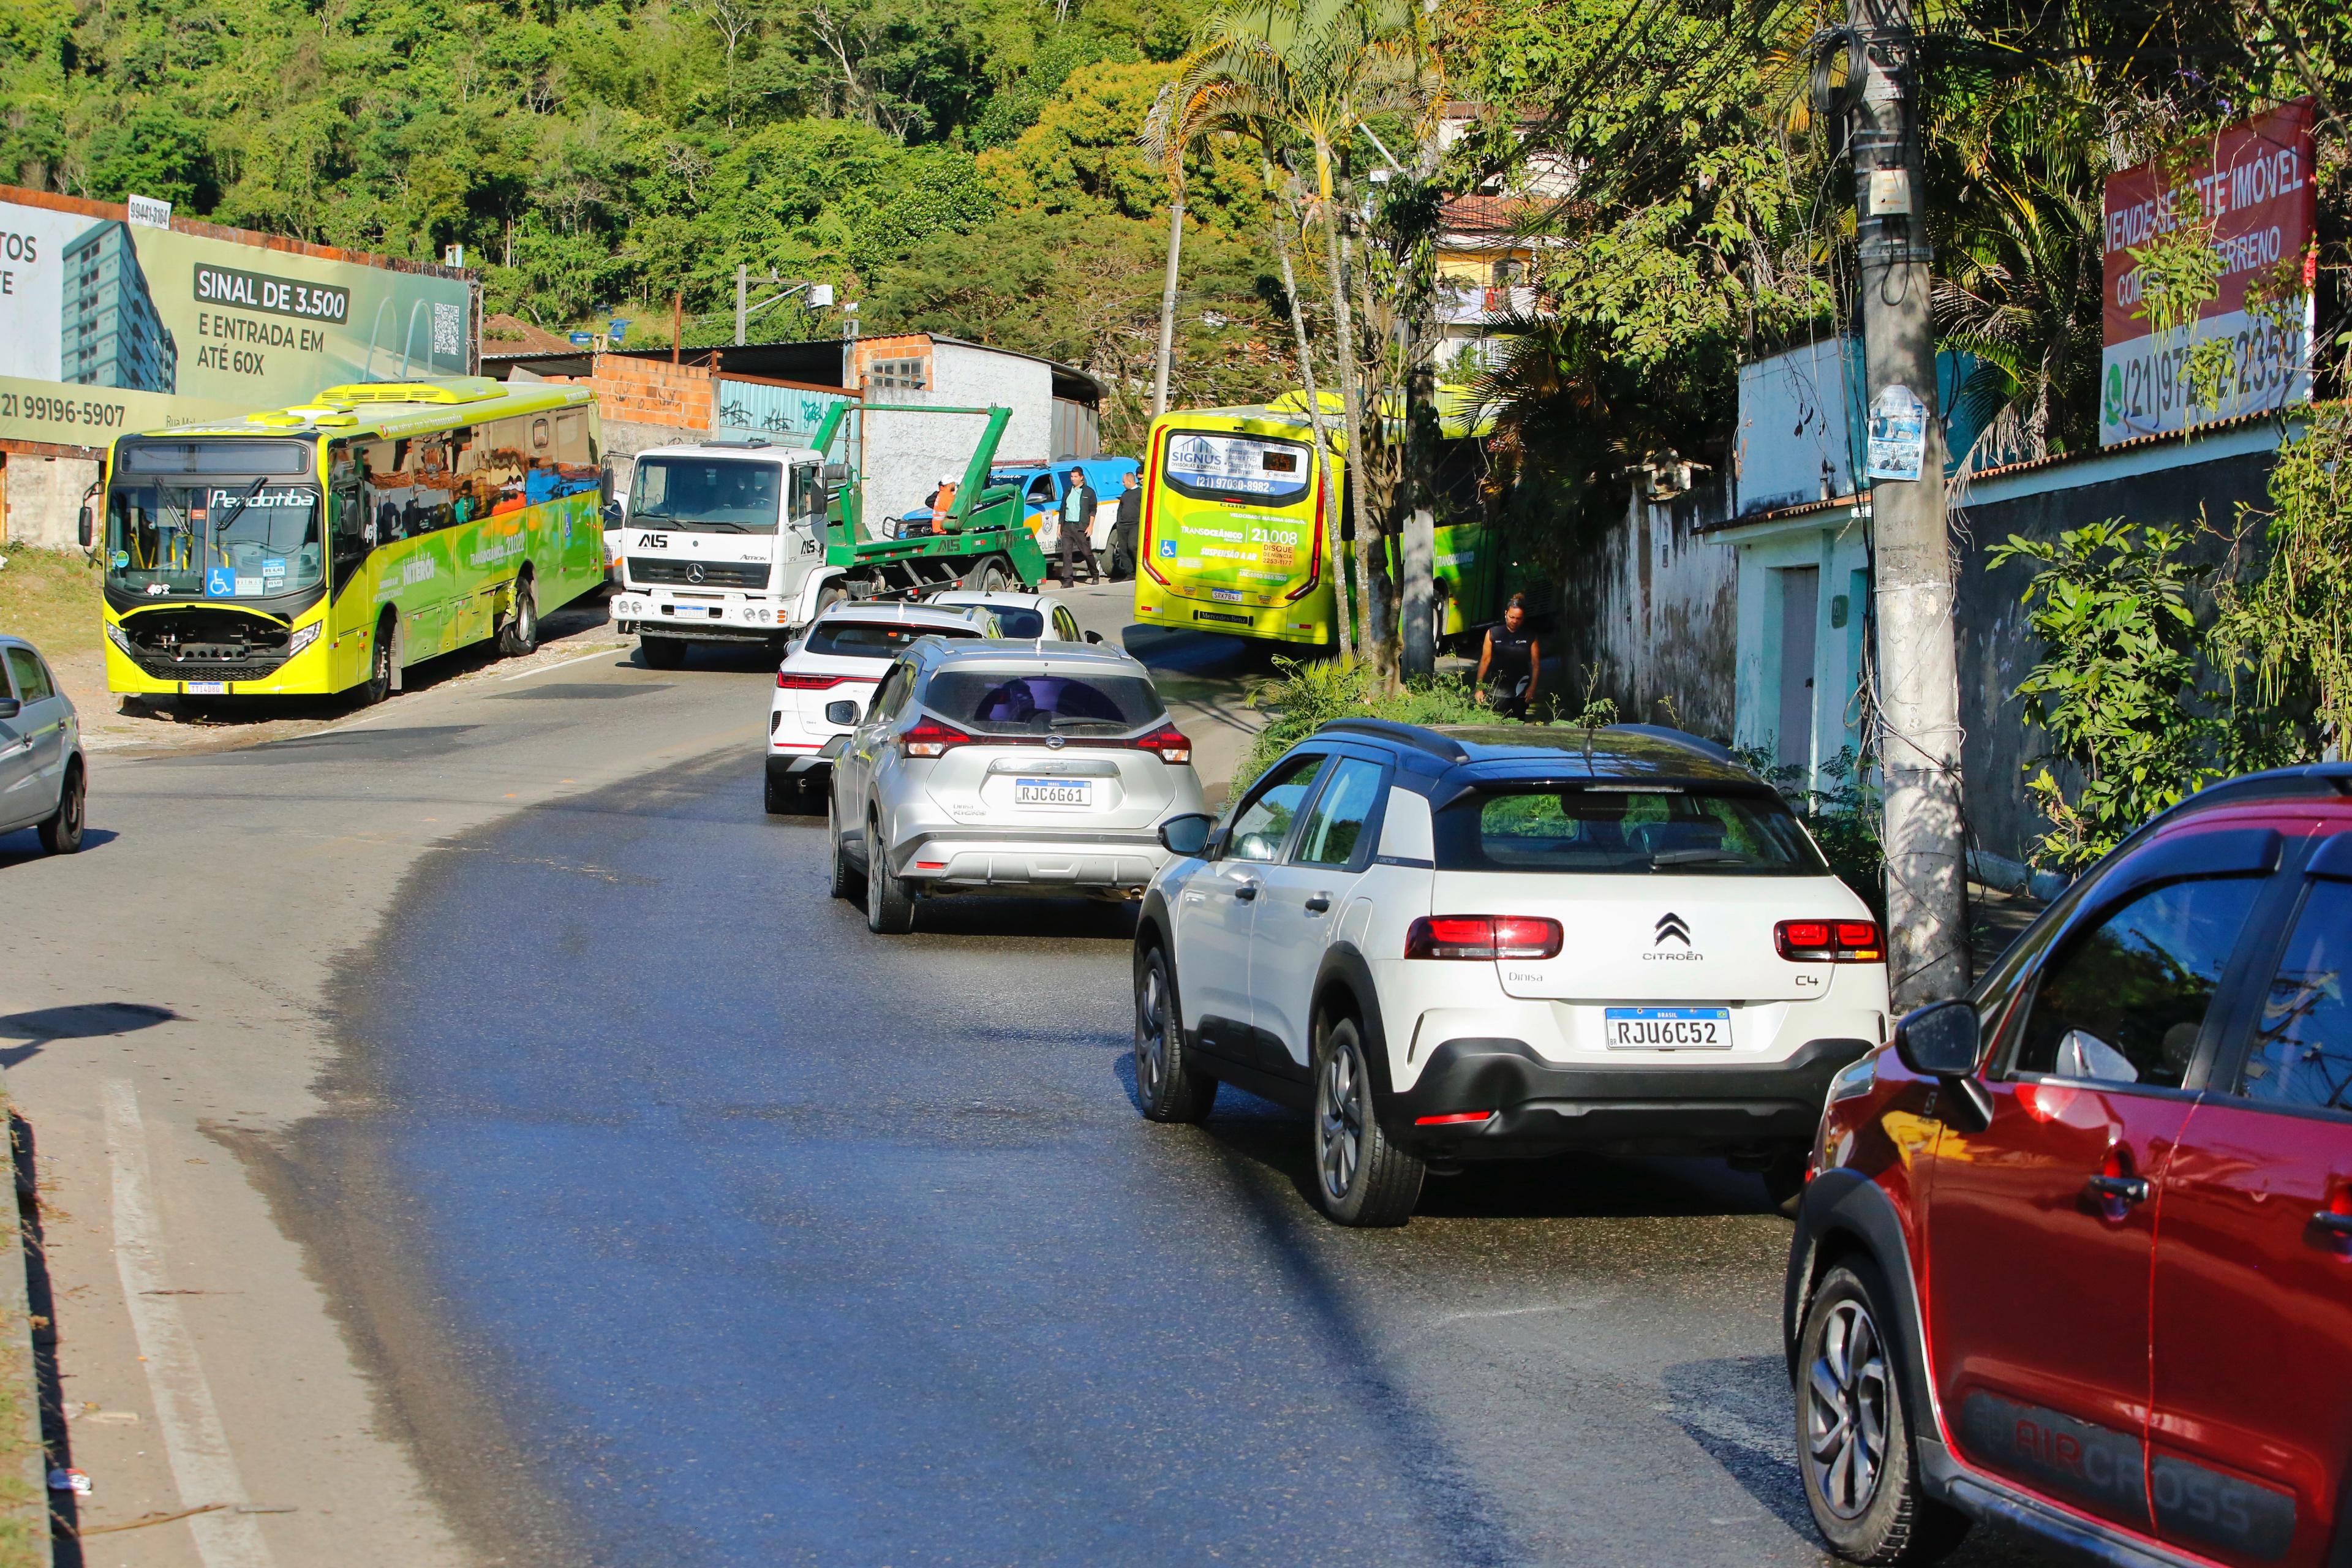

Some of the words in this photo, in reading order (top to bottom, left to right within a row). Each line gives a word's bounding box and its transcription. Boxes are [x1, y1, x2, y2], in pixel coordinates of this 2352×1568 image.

[2231, 146, 2304, 211] IMÓVEL
[198, 270, 258, 305] SINAL
[263, 281, 291, 311] DE
[295, 286, 345, 318] 3.500
[199, 312, 209, 335] E
[214, 315, 295, 349] ENTRADA
[300, 329, 324, 353] EM
[197, 343, 228, 371] ATÉ
[233, 350, 265, 375] 60X
[2, 393, 18, 417] 21
[23, 395, 125, 427] 99196-5907
[1172, 451, 1221, 466] SIGNUS
[1196, 476, 1214, 489] (21)
[1216, 478, 1270, 492] 97030-8982
[1181, 526, 1243, 540] TRANSOCEÂNICO
[638, 534, 668, 548] ALS
[801, 540, 815, 555] ALS
[937, 539, 960, 552] ALS
[1264, 544, 1292, 553] DISQUE
[1022, 787, 1082, 802] RJC6G61
[1509, 971, 1543, 982] Dinisa
[1795, 976, 1819, 986] C4
[1618, 1022, 1717, 1044] RJU6C52
